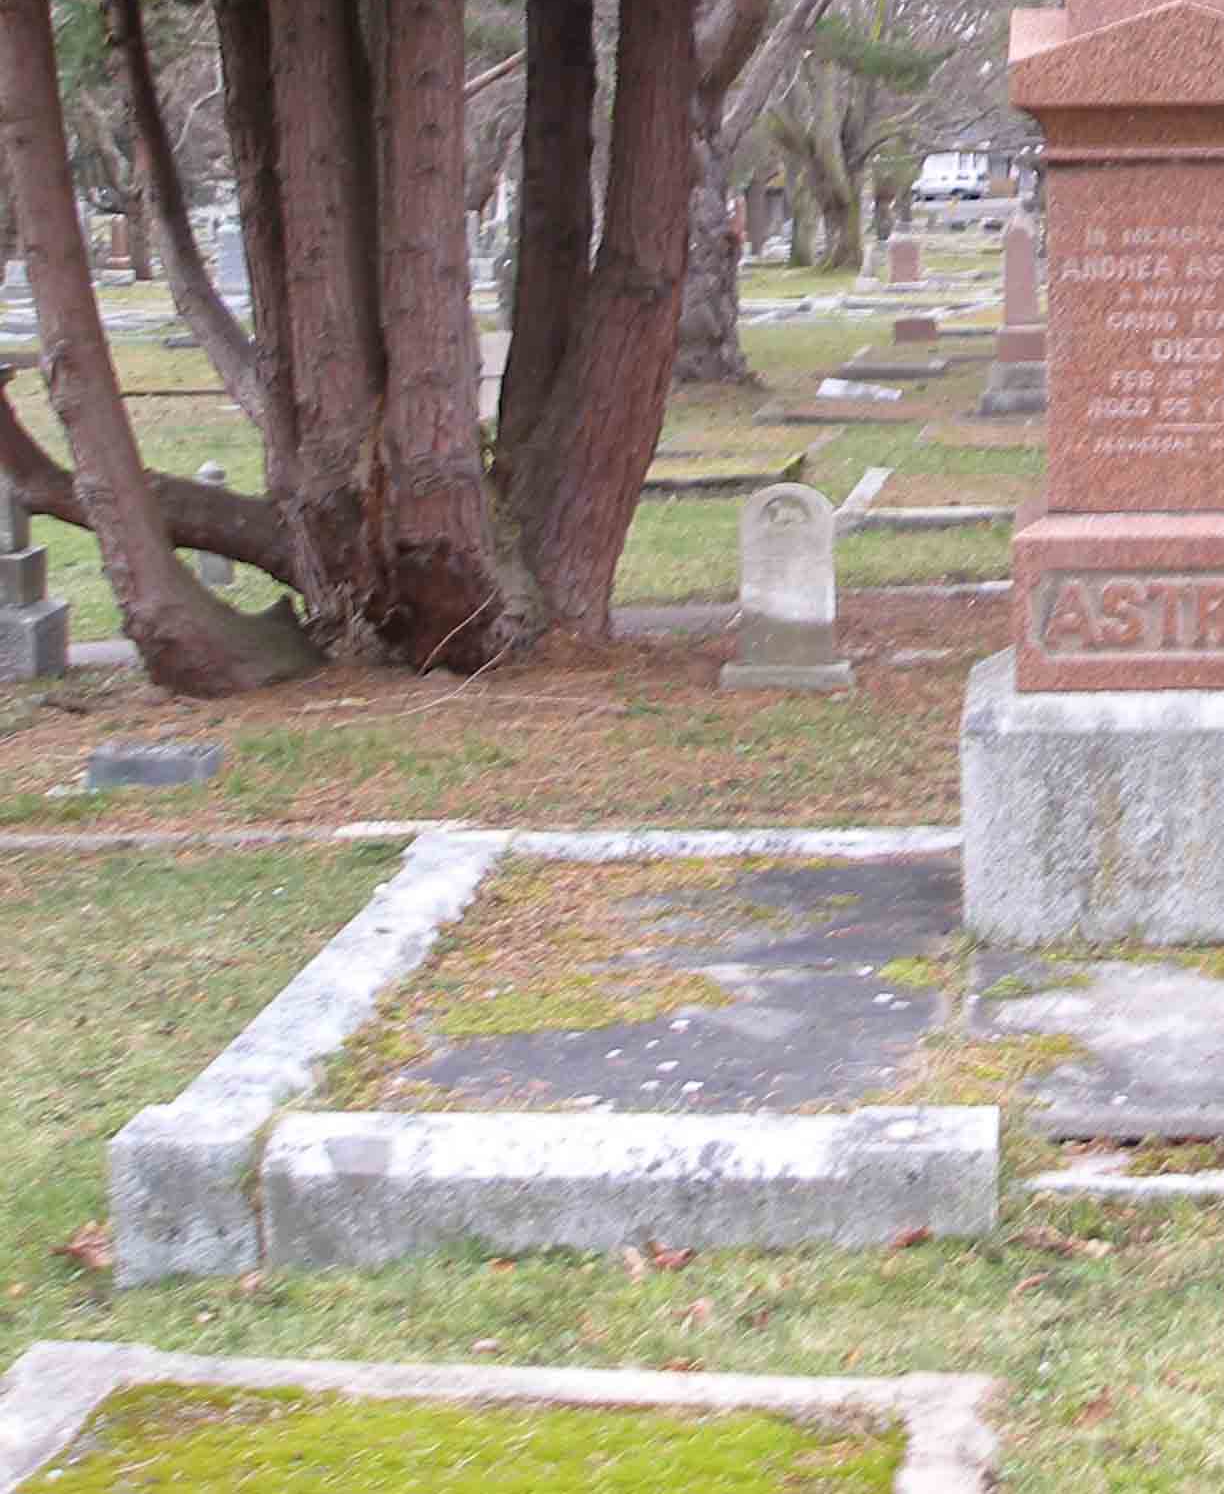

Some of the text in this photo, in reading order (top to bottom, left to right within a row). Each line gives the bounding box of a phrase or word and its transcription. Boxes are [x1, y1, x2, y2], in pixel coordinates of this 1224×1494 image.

[1061, 253, 1174, 281] ANDREA
[1140, 285, 1217, 304] NATIVE
[1150, 337, 1224, 364] DIED
[1086, 395, 1152, 420] AGED
